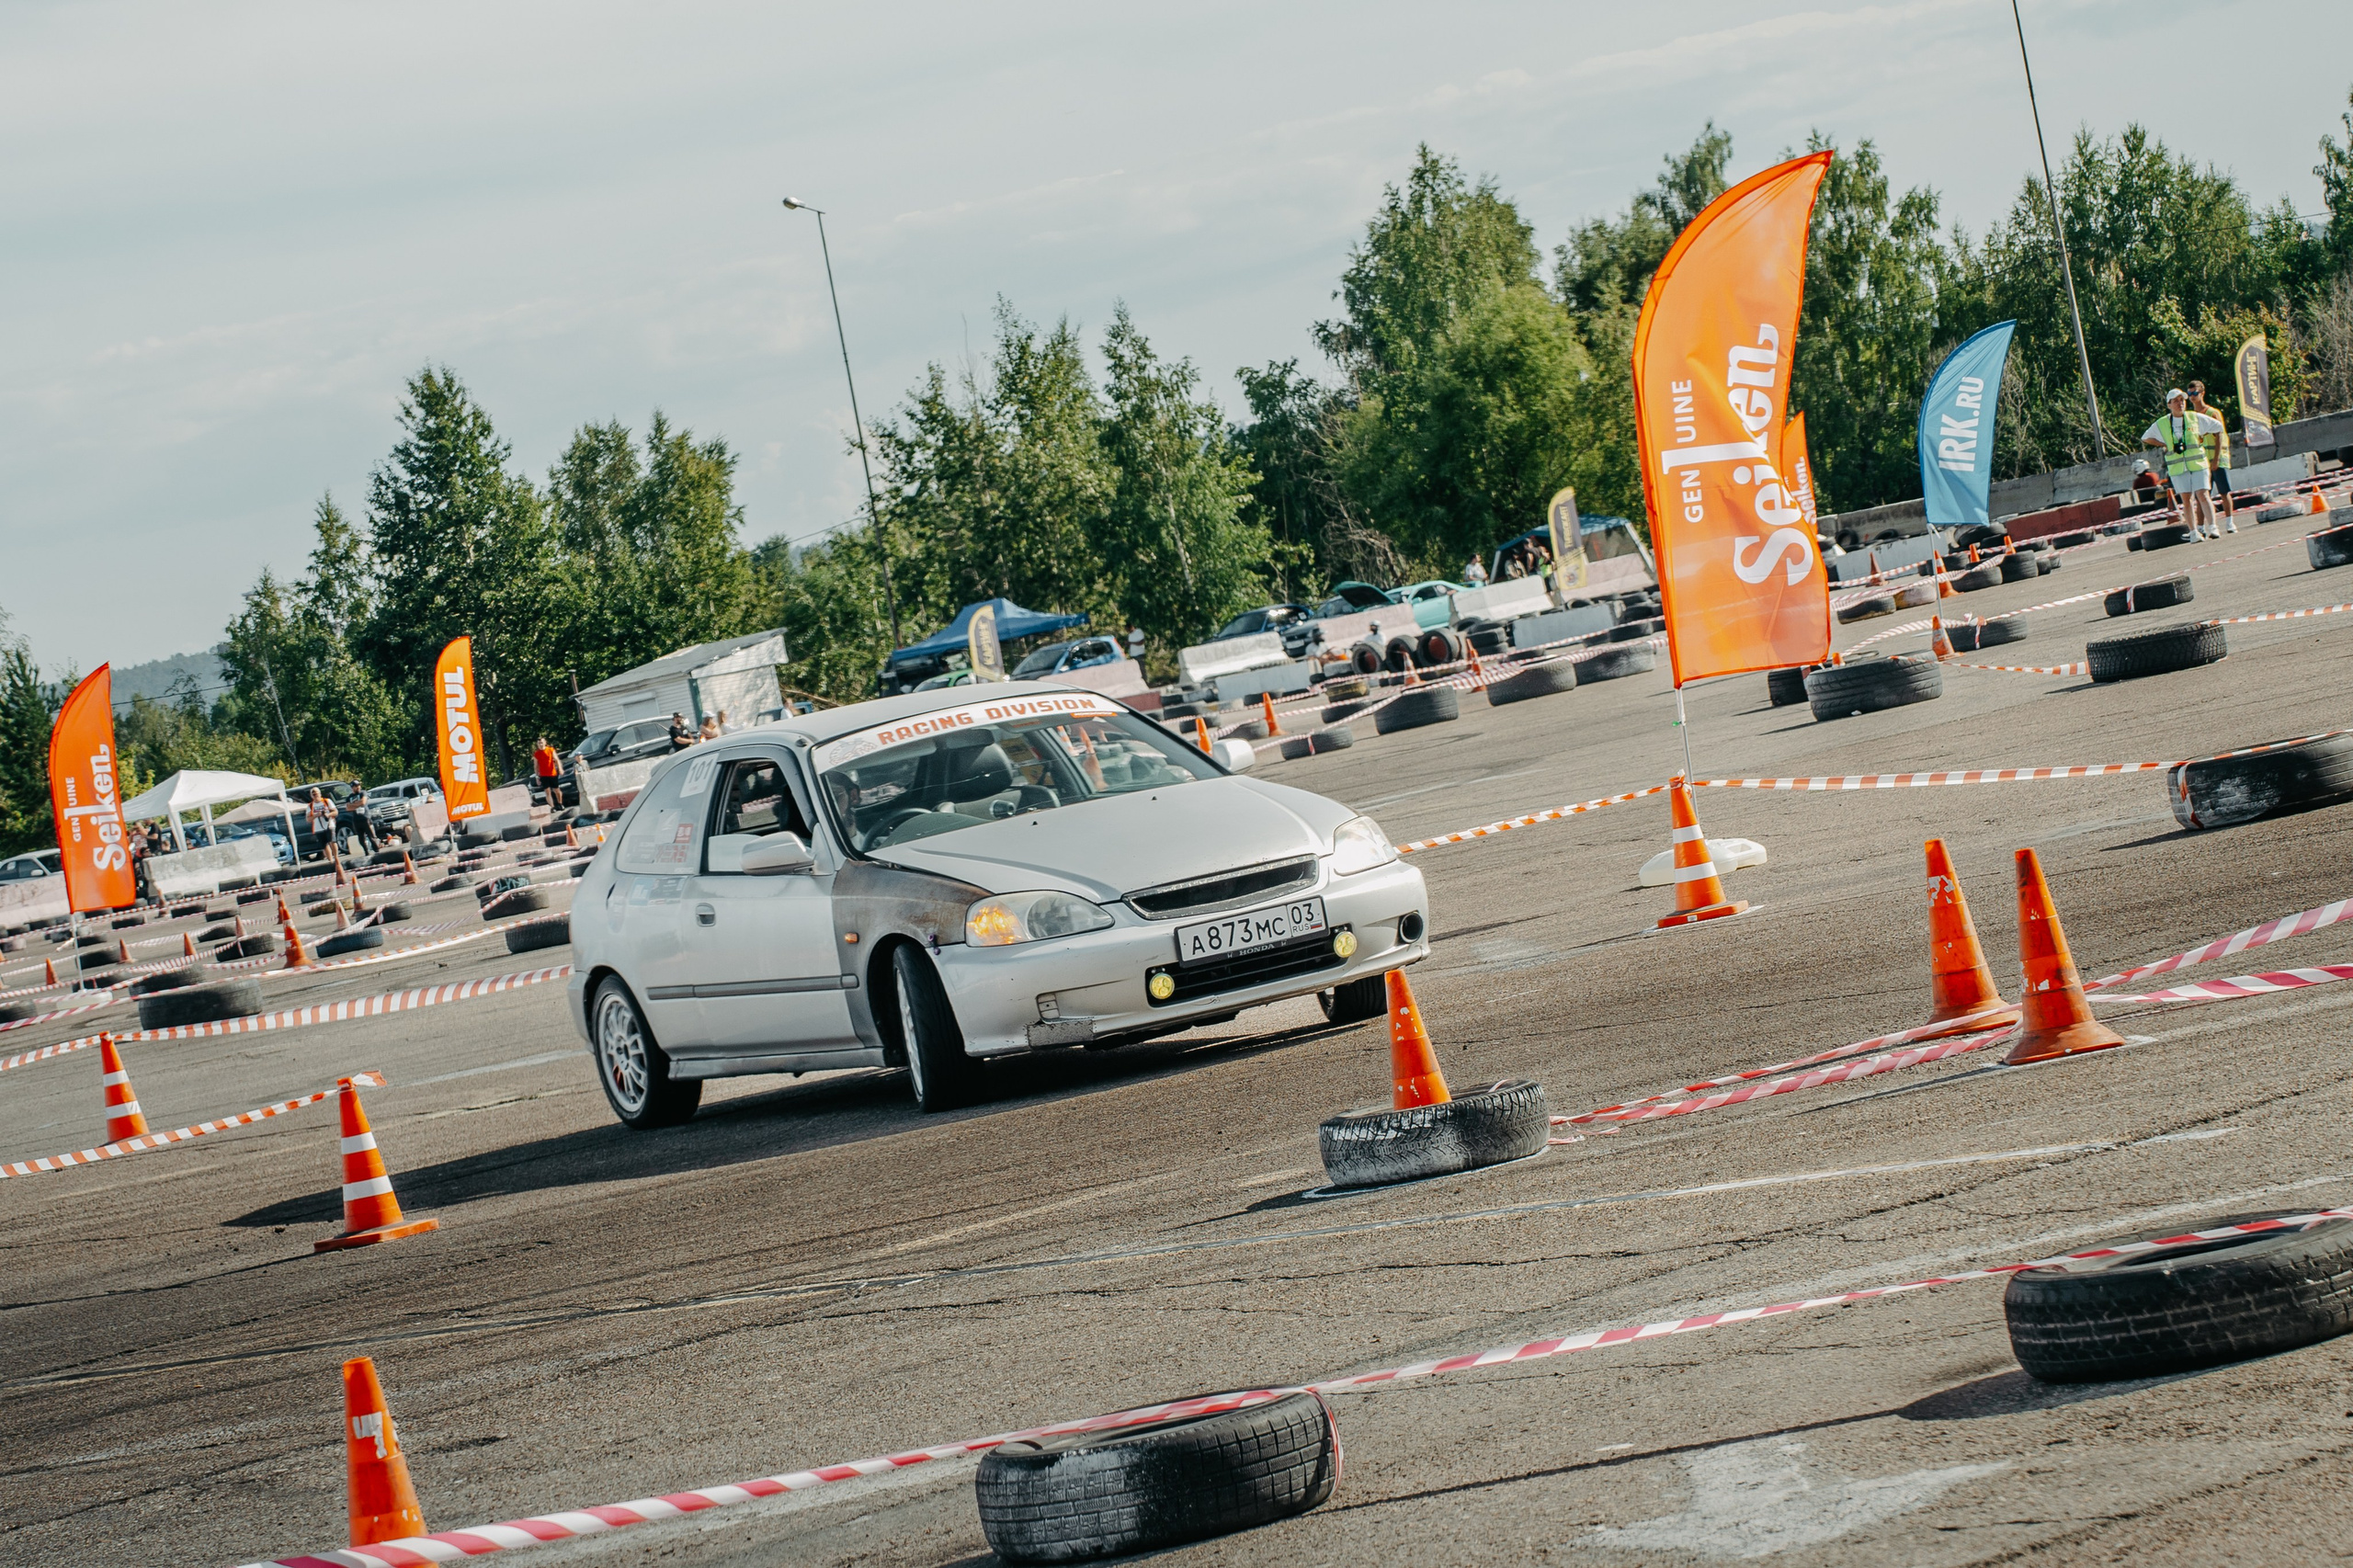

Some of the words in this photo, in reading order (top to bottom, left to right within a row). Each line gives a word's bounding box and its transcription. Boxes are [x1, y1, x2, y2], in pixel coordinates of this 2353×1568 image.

[2245, 351, 2260, 405] КАРТИНГ
[1938, 376, 1984, 472] IRK.RU
[1661, 323, 1814, 586] Seiken
[443, 665, 480, 784] MOTUL
[877, 711, 973, 745] RACING
[984, 699, 1096, 721] DIVISION
[688, 758, 714, 784] 101
[63, 743, 127, 871] Seiken
[451, 801, 484, 816] MOTUL
[1290, 903, 1314, 925] 03
[1292, 923, 1310, 933] RUS
[1239, 943, 1276, 957] HONDA
